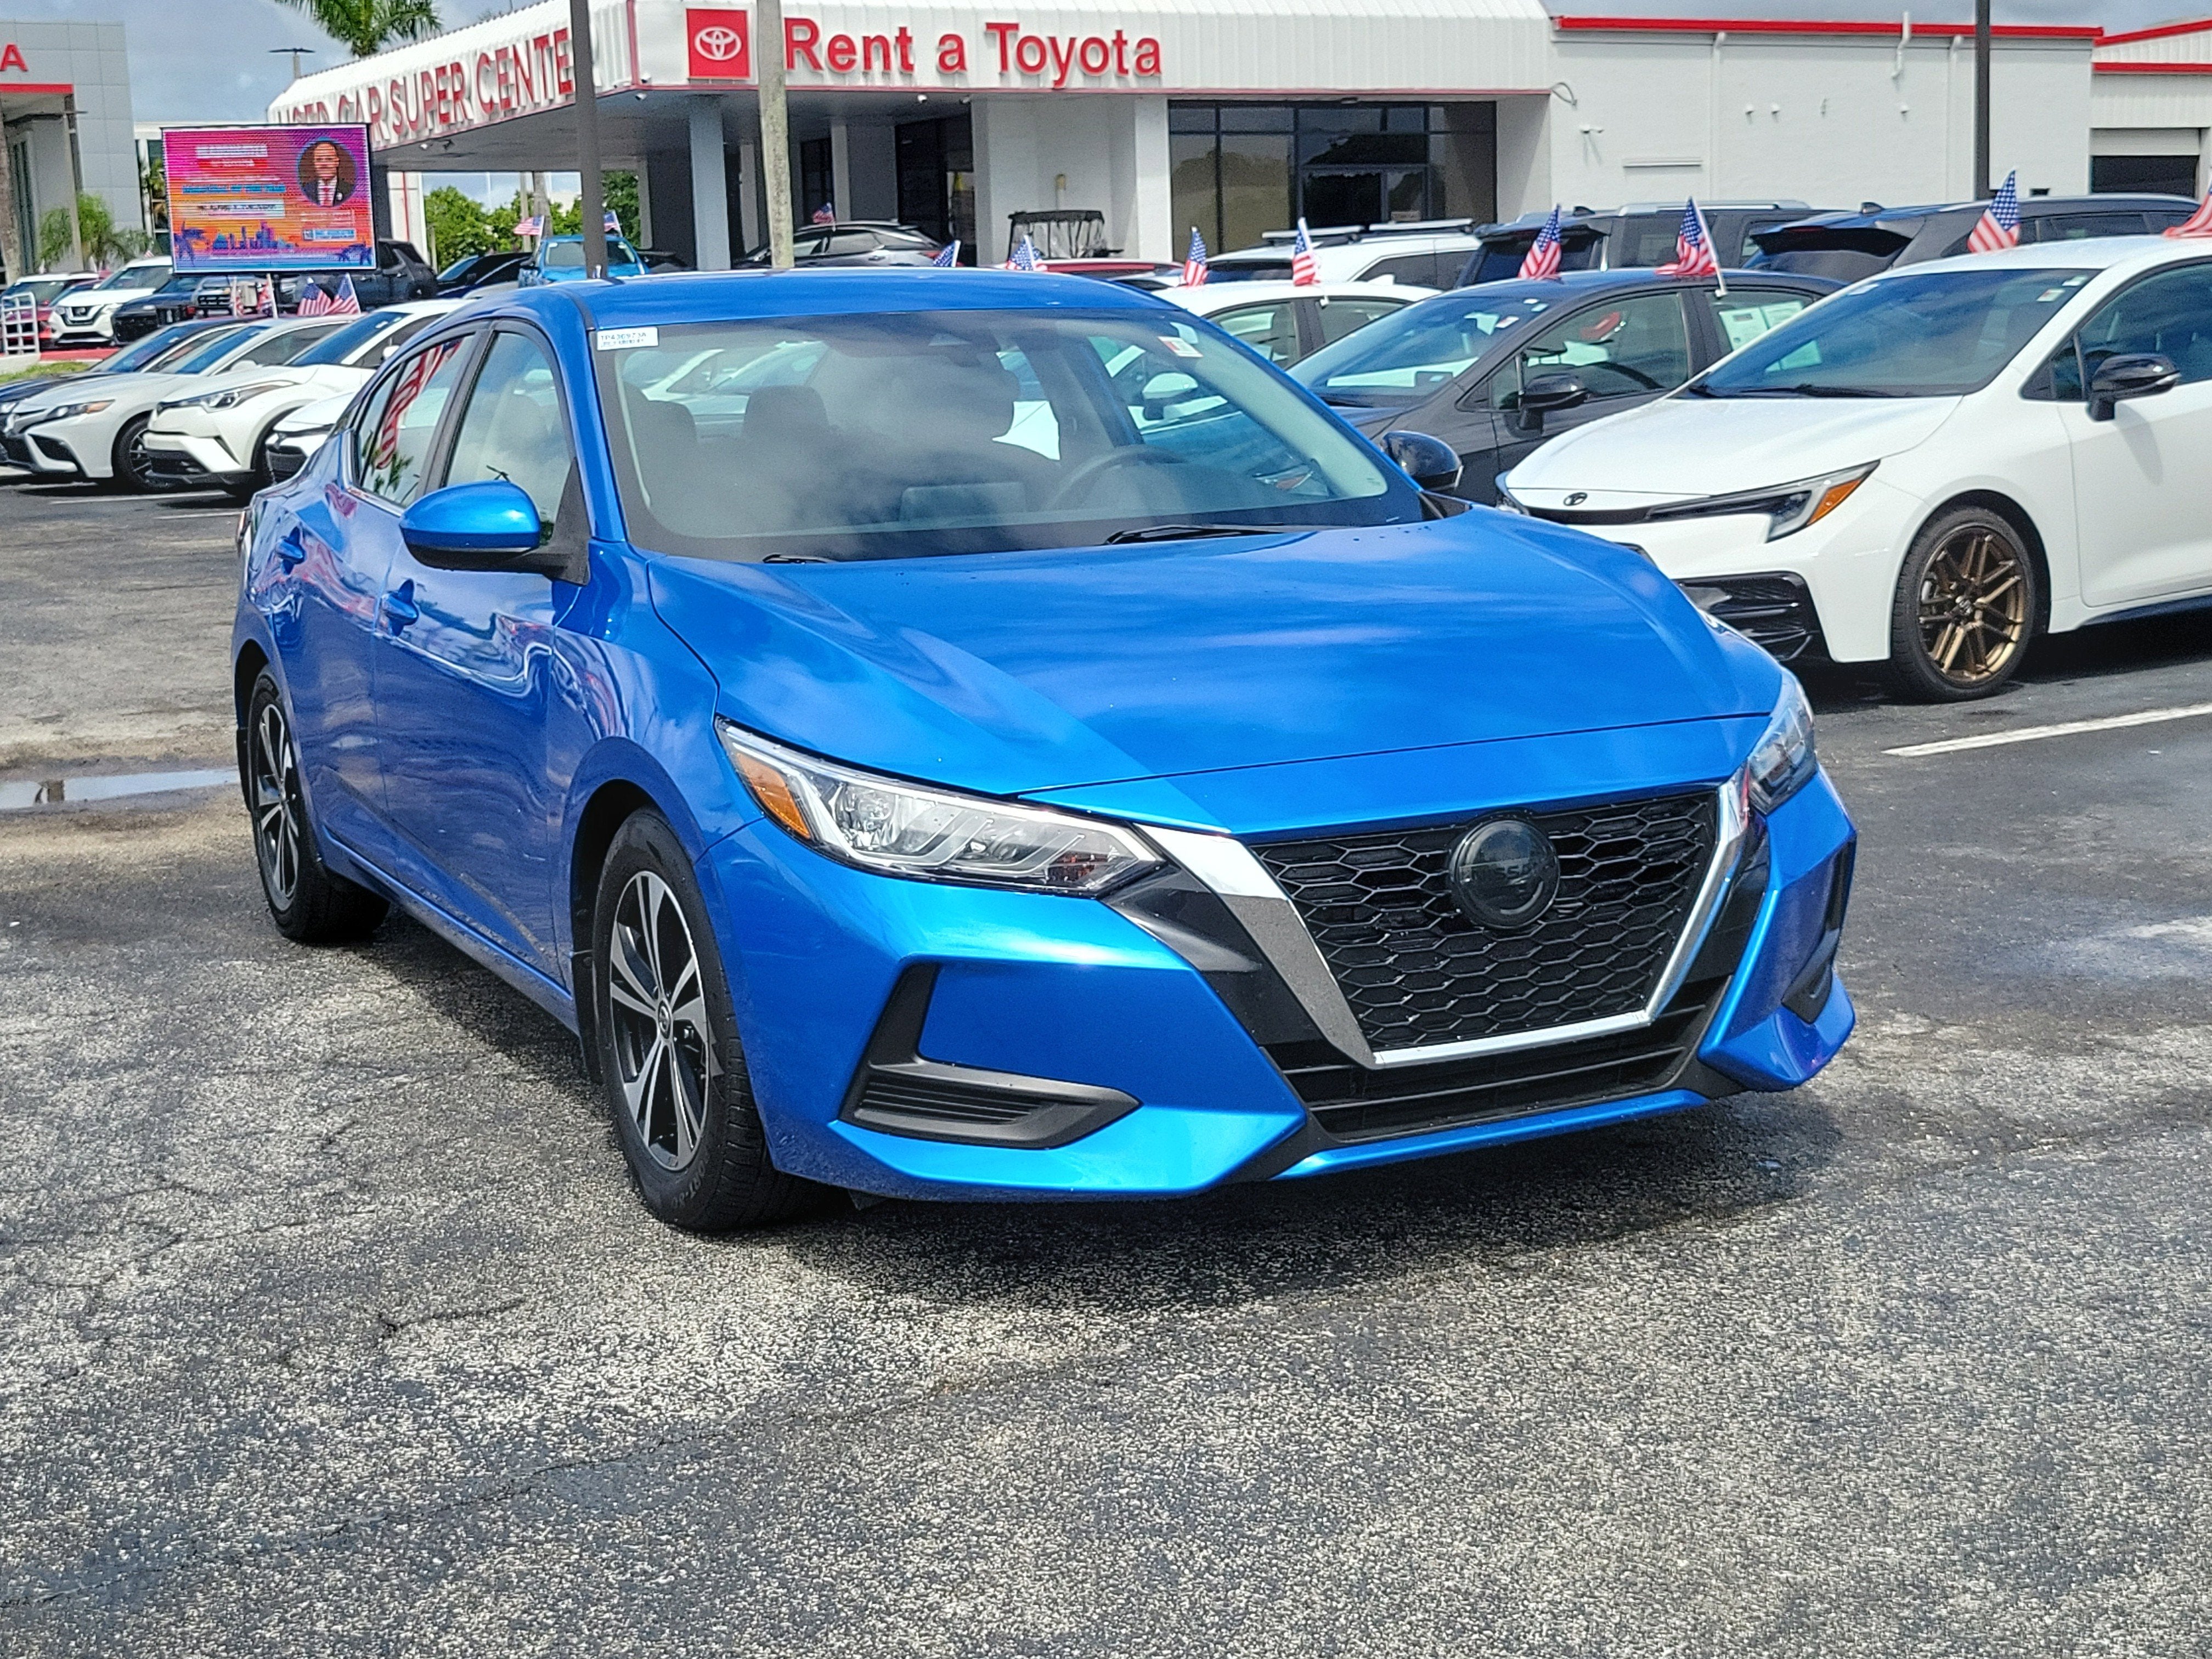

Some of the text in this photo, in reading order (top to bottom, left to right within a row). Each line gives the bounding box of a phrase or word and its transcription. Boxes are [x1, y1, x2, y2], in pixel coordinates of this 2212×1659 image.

[390, 61, 473, 136] SUPER
[476, 26, 576, 116] CENTE
[784, 17, 1162, 89] Rent a Toyota
